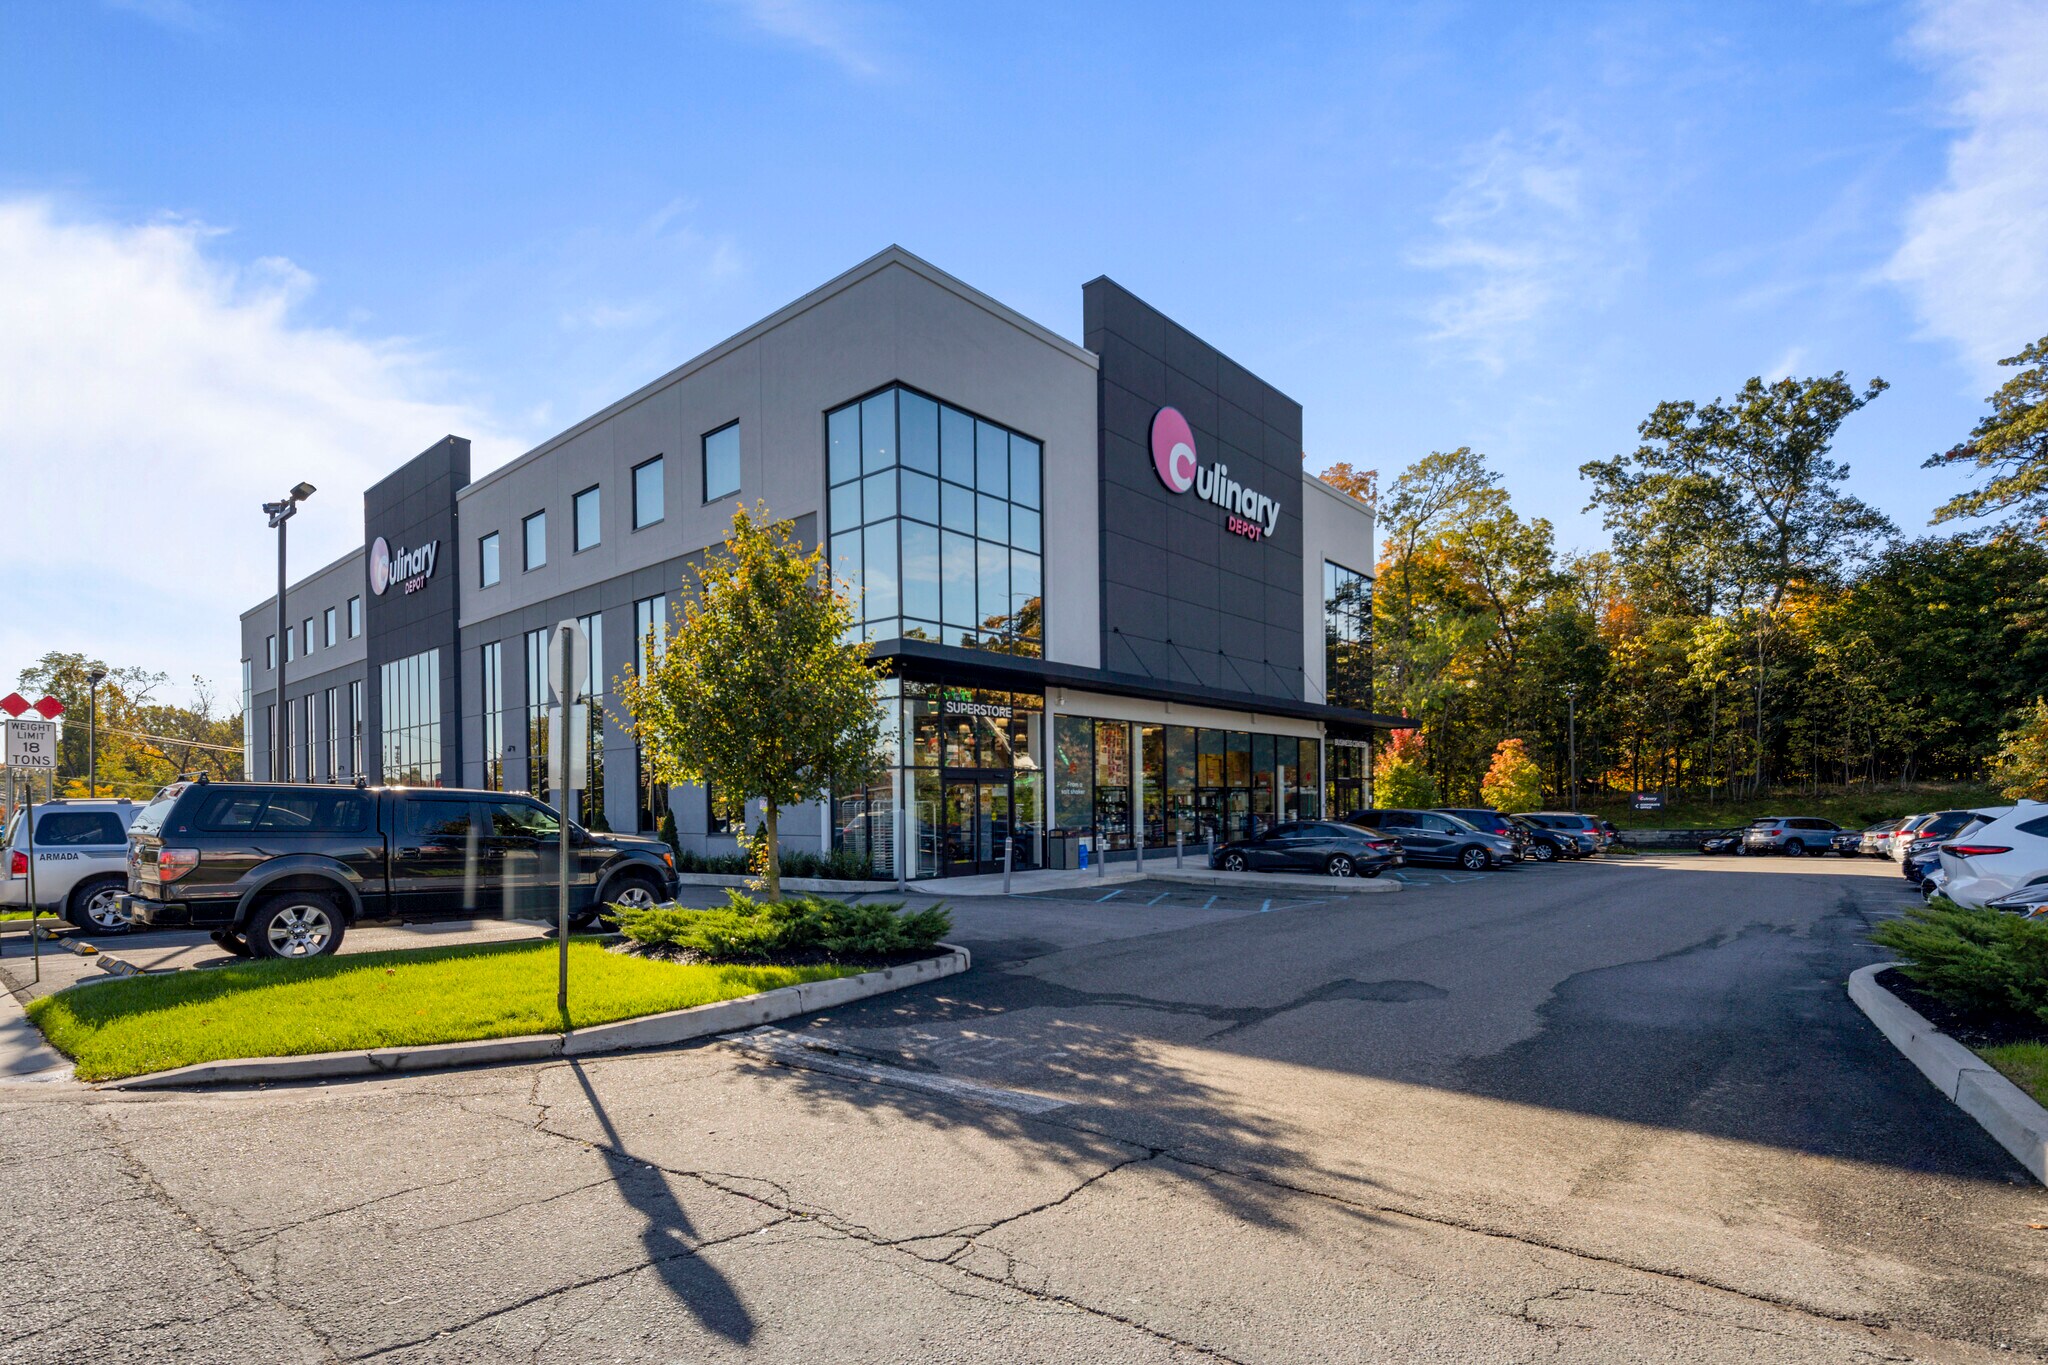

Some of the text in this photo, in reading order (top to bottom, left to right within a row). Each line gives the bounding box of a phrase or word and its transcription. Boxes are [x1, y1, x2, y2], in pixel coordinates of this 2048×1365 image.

[1168, 441, 1281, 538] Culinary
[1227, 515, 1262, 541] DEPOT
[377, 540, 438, 588] Culinary
[404, 575, 425, 595] DEPOT
[946, 700, 1012, 718] SUPERSTORE
[11, 722, 51, 732] WEIGHT
[17, 732, 45, 740] LIMIT
[22, 741, 40, 753] 18
[12, 754, 51, 766] TONS
[39, 852, 79, 861] ARMADA
